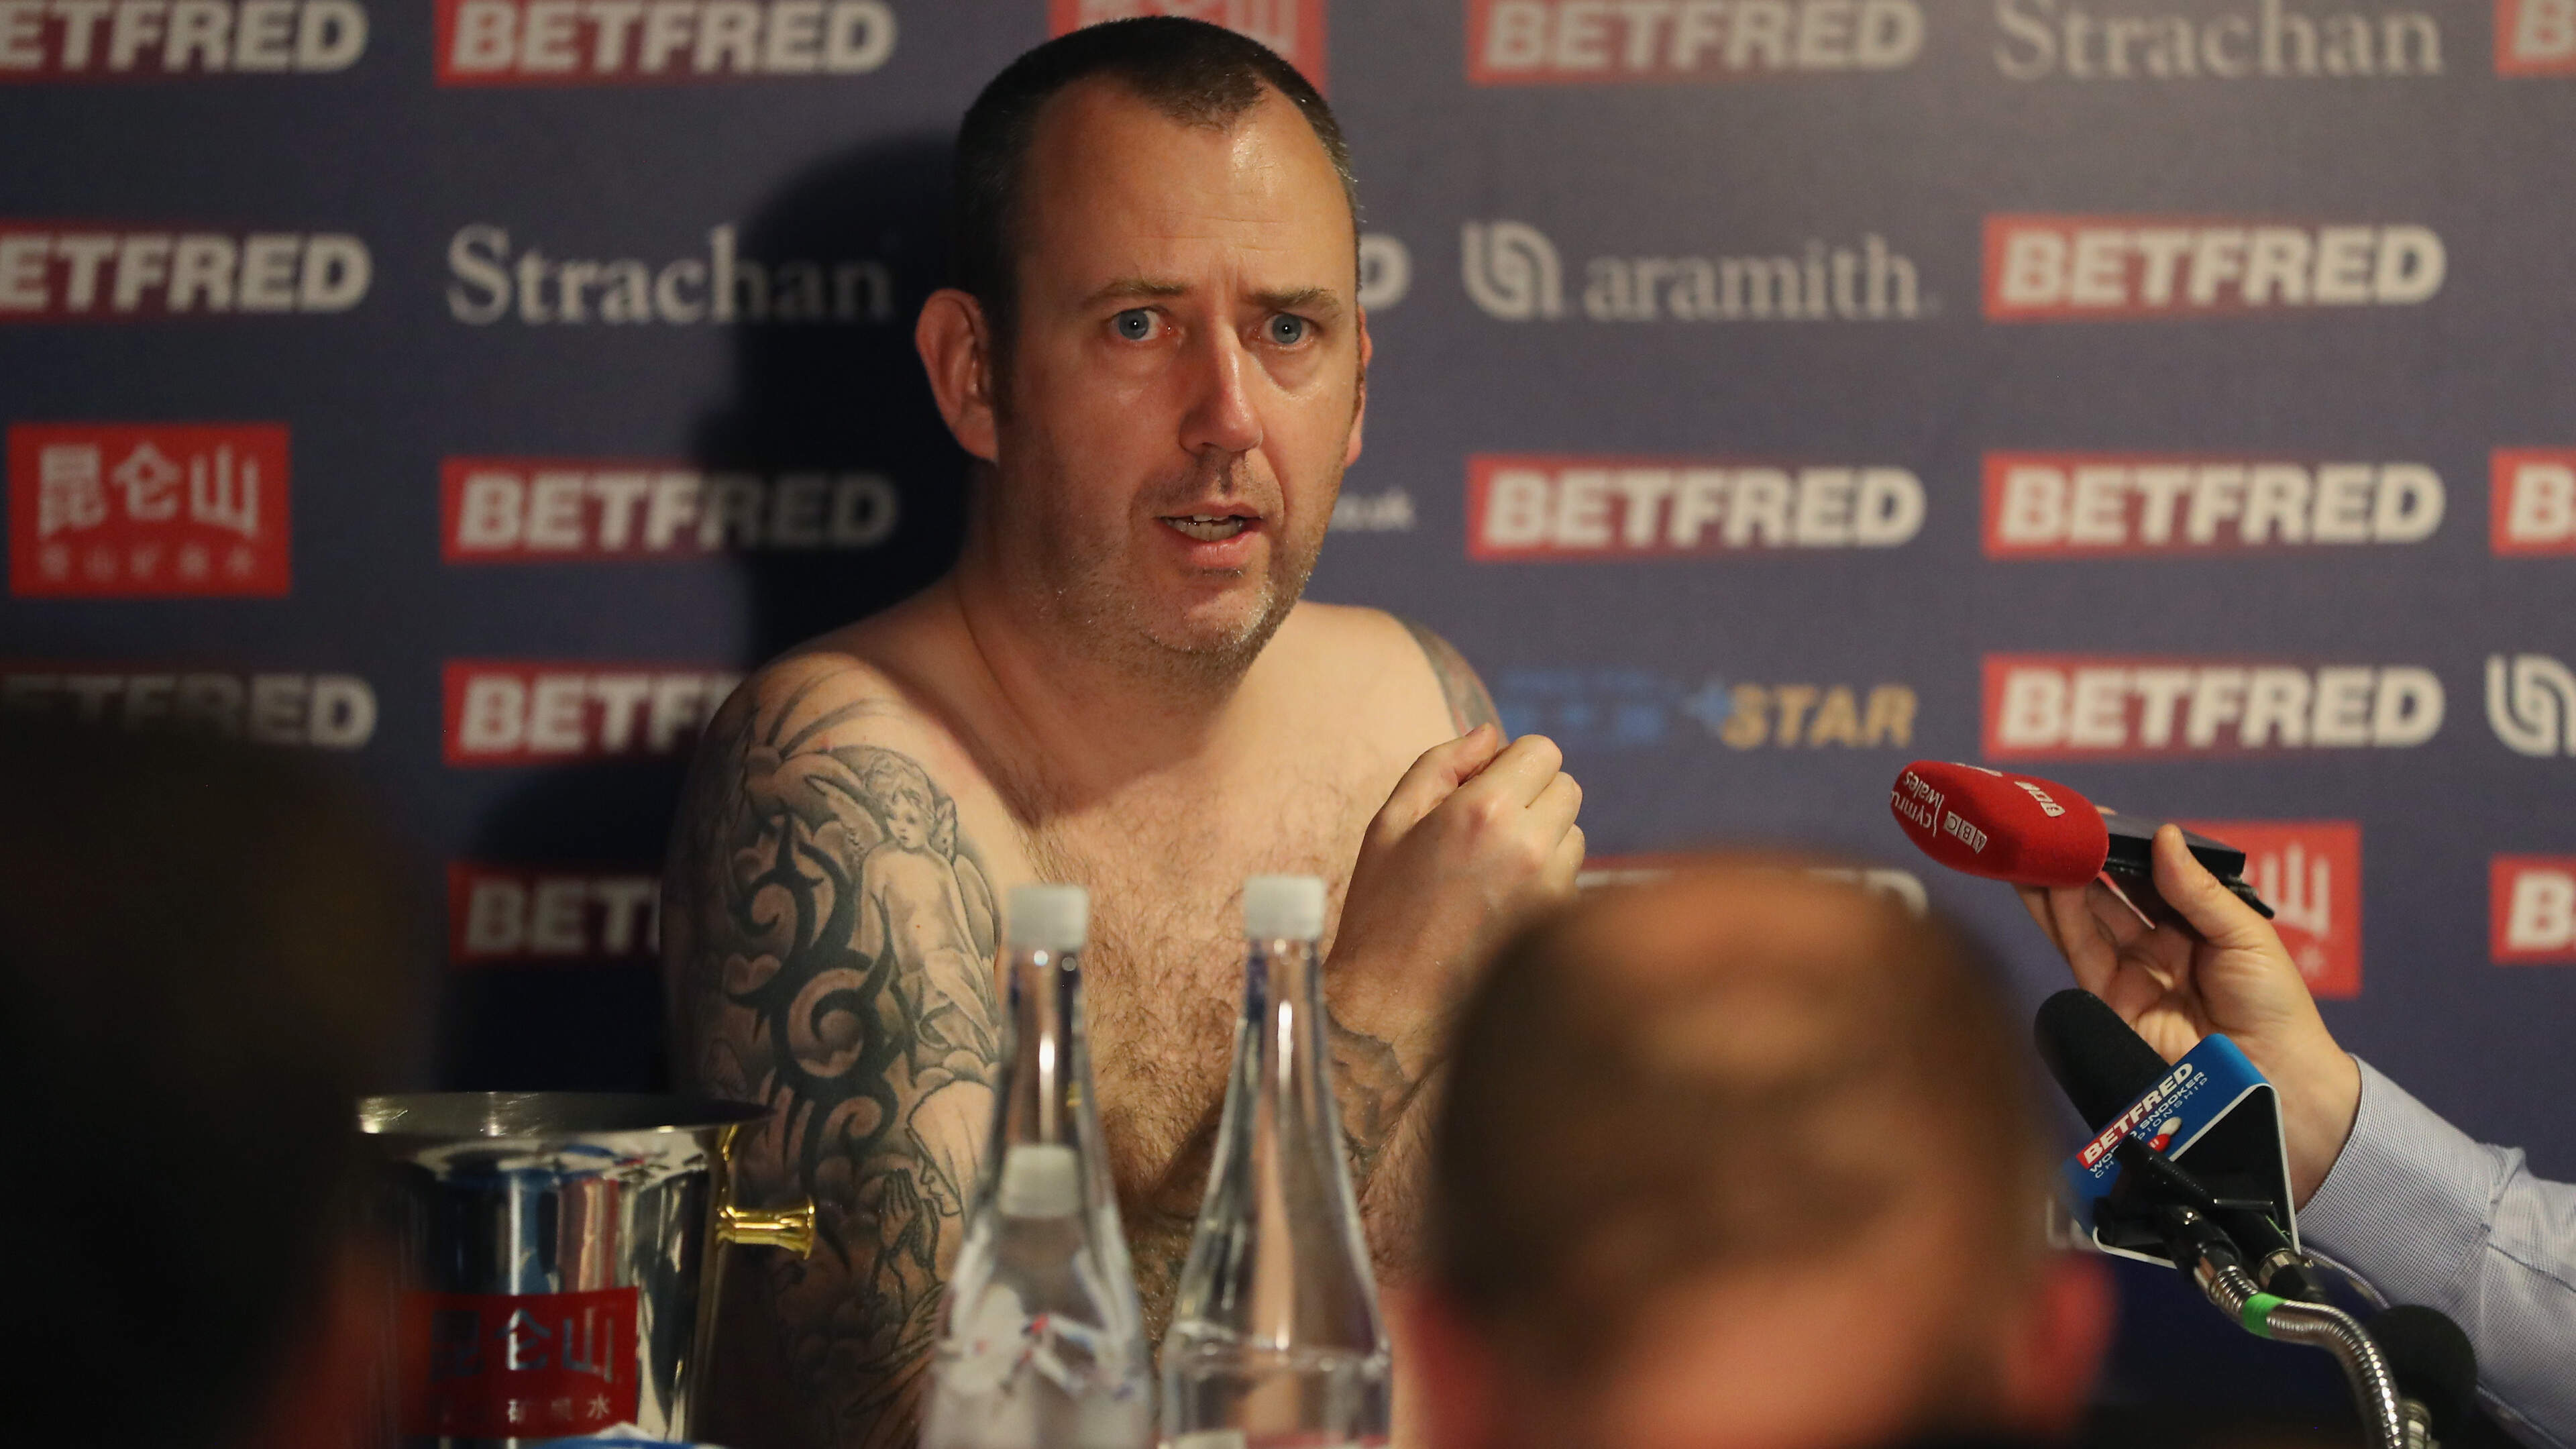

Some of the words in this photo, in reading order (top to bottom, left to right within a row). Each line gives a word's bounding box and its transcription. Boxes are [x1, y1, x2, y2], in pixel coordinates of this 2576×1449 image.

[0, 0, 369, 72] ETFRED
[452, 0, 898, 74] BETFRED
[1484, 0, 1925, 70] BETFRED
[1992, 0, 2445, 79] Strachan
[0, 233, 373, 314] ETFRED
[447, 223, 895, 325] Strachan
[1582, 231, 1920, 322] aramith
[2000, 224, 2448, 307] BETFRED
[458, 470, 900, 551] BETFRED
[1484, 466, 1927, 549] BETFRED
[2000, 462, 2446, 545] BETFRED
[460, 674, 737, 753] BETF
[1723, 683, 1917, 750] STAR
[2000, 666, 2446, 749] BETFRED
[1904, 771, 1943, 808] wales
[2084, 1063, 2193, 1164] BETFRED
[2095, 1077, 2208, 1179] CHPIONSHIP
[2140, 1071, 2205, 1130] SNOOKER
[429, 1308, 615, 1384] 昆仑山
